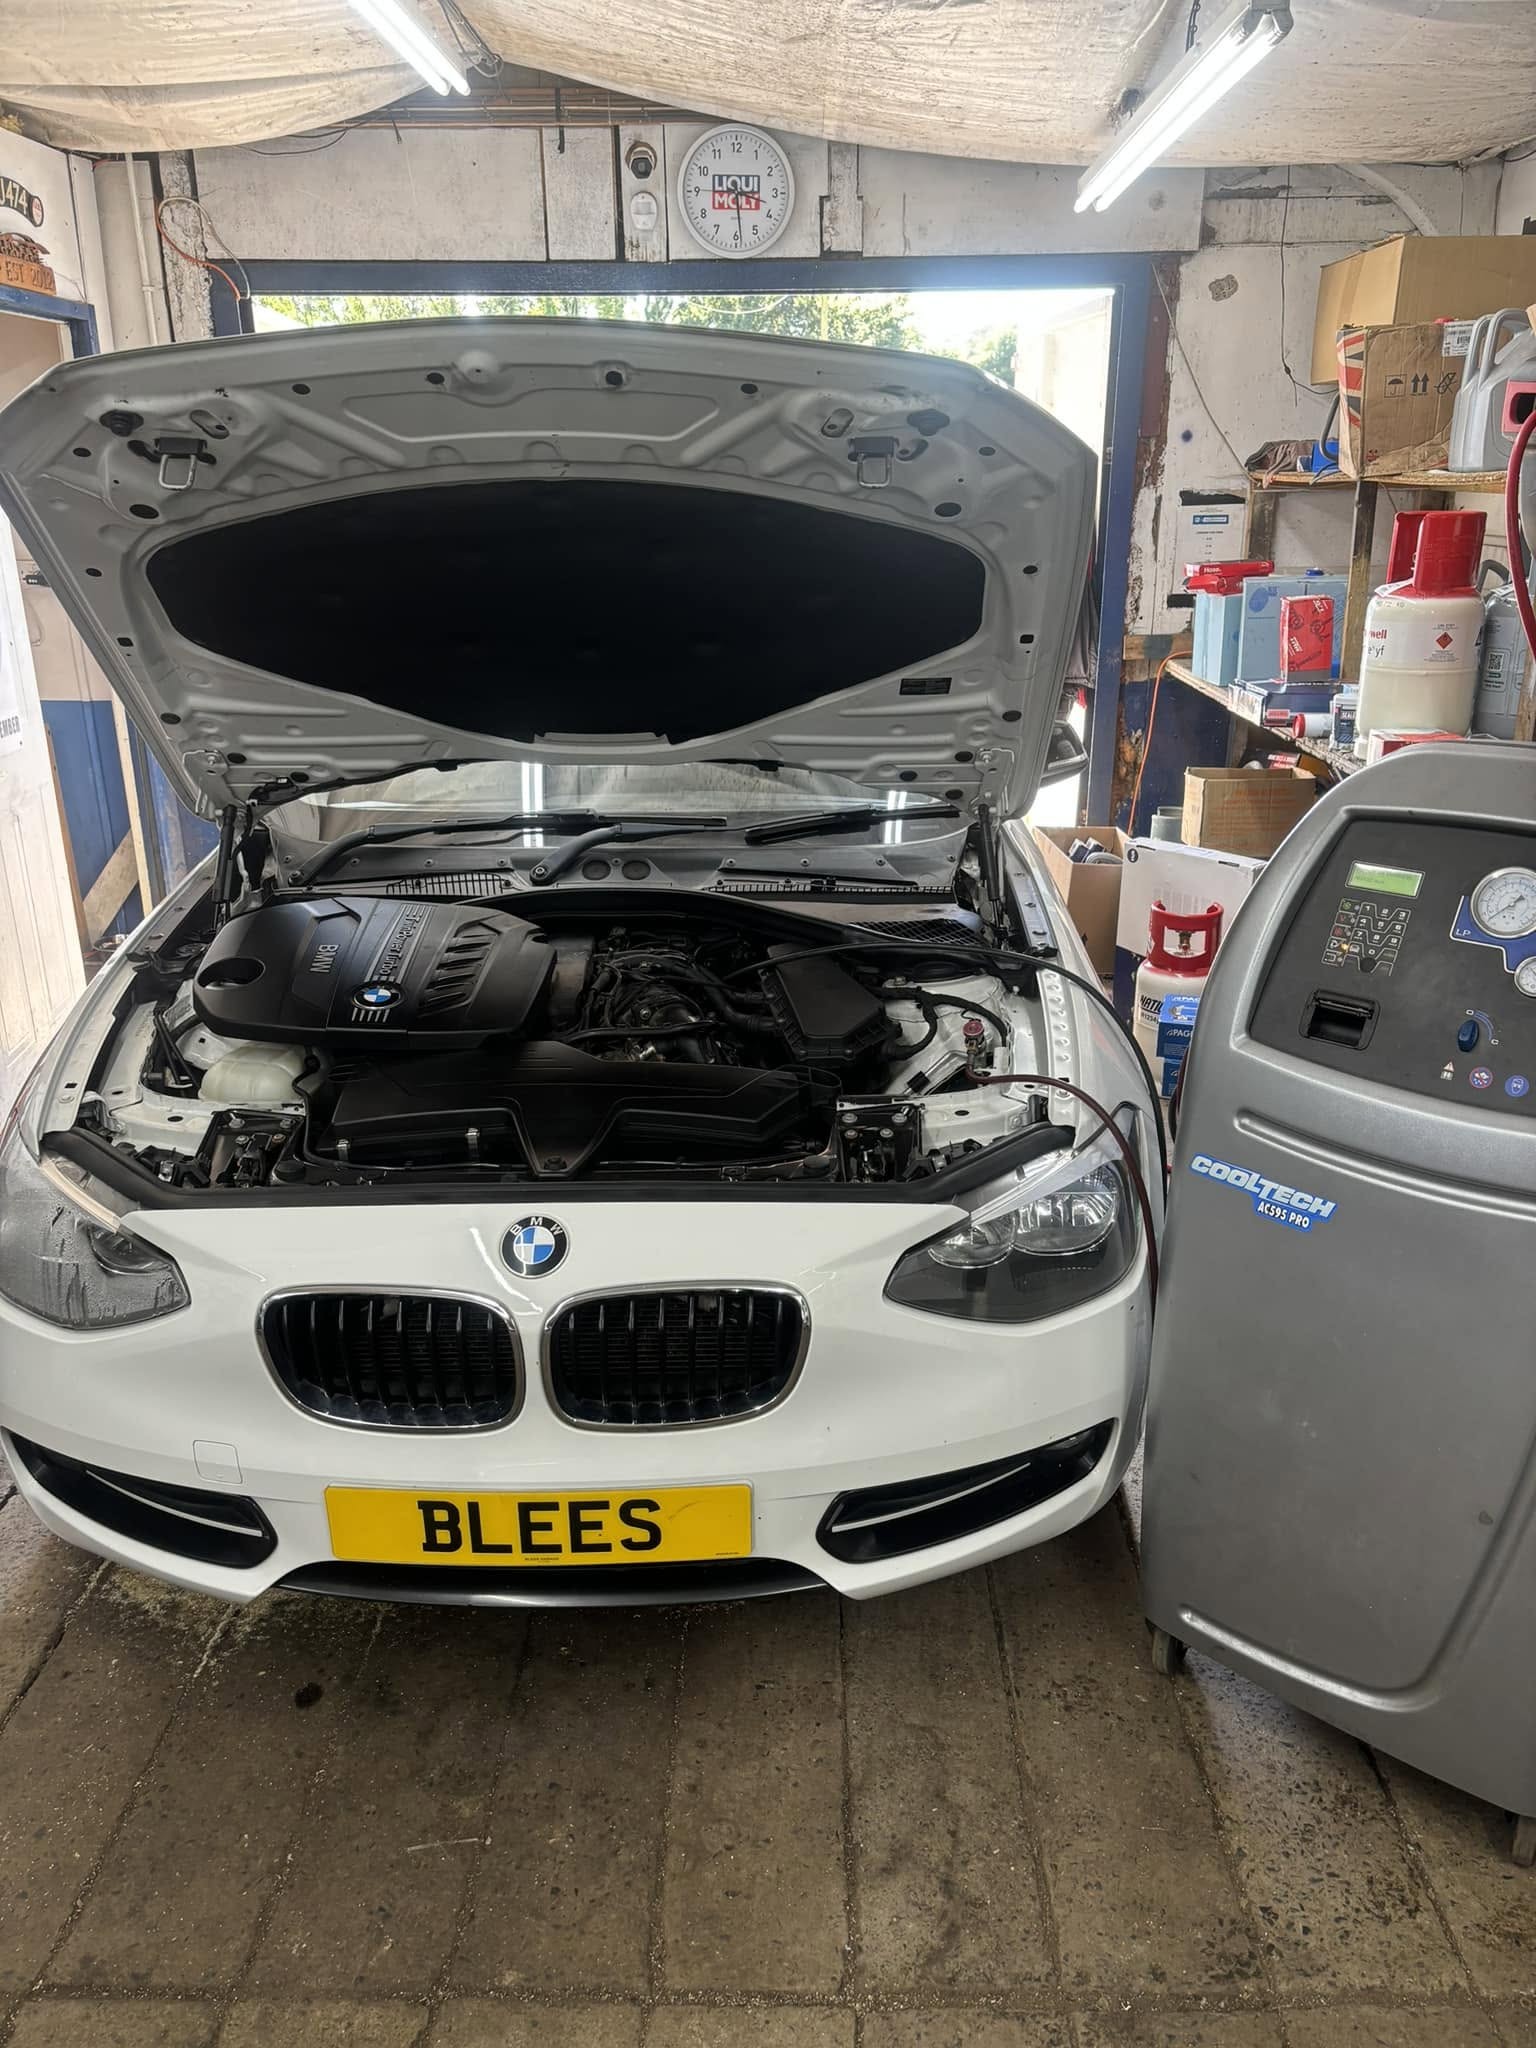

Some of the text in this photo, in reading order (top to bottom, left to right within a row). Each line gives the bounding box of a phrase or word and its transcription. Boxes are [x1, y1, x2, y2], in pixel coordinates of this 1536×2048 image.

[731, 142, 742, 153] 12
[712, 149, 721, 160] 11
[754, 149, 759, 161] 1
[698, 166, 709, 177] 10
[767, 166, 774, 177] 2
[714, 175, 759, 191] LIQUI
[694, 186, 700, 197] 9
[772, 187, 779, 198] 3
[714, 192, 759, 210] MOLY
[701, 208, 708, 219] 8
[766, 209, 773, 220] 4
[713, 224, 721, 236] 7
[733, 231, 740, 241] 6
[752, 224, 759, 236] 5
[5, 261, 24, 283] EST
[1455, 929, 1471, 937] LP
[310, 944, 339, 973] BMW
[1191, 1155, 1336, 1218] COOLTECH
[1257, 1202, 1311, 1228] AC595 PRO
[509, 1216, 563, 1236] BMW
[417, 1499, 662, 1554] BLEES
